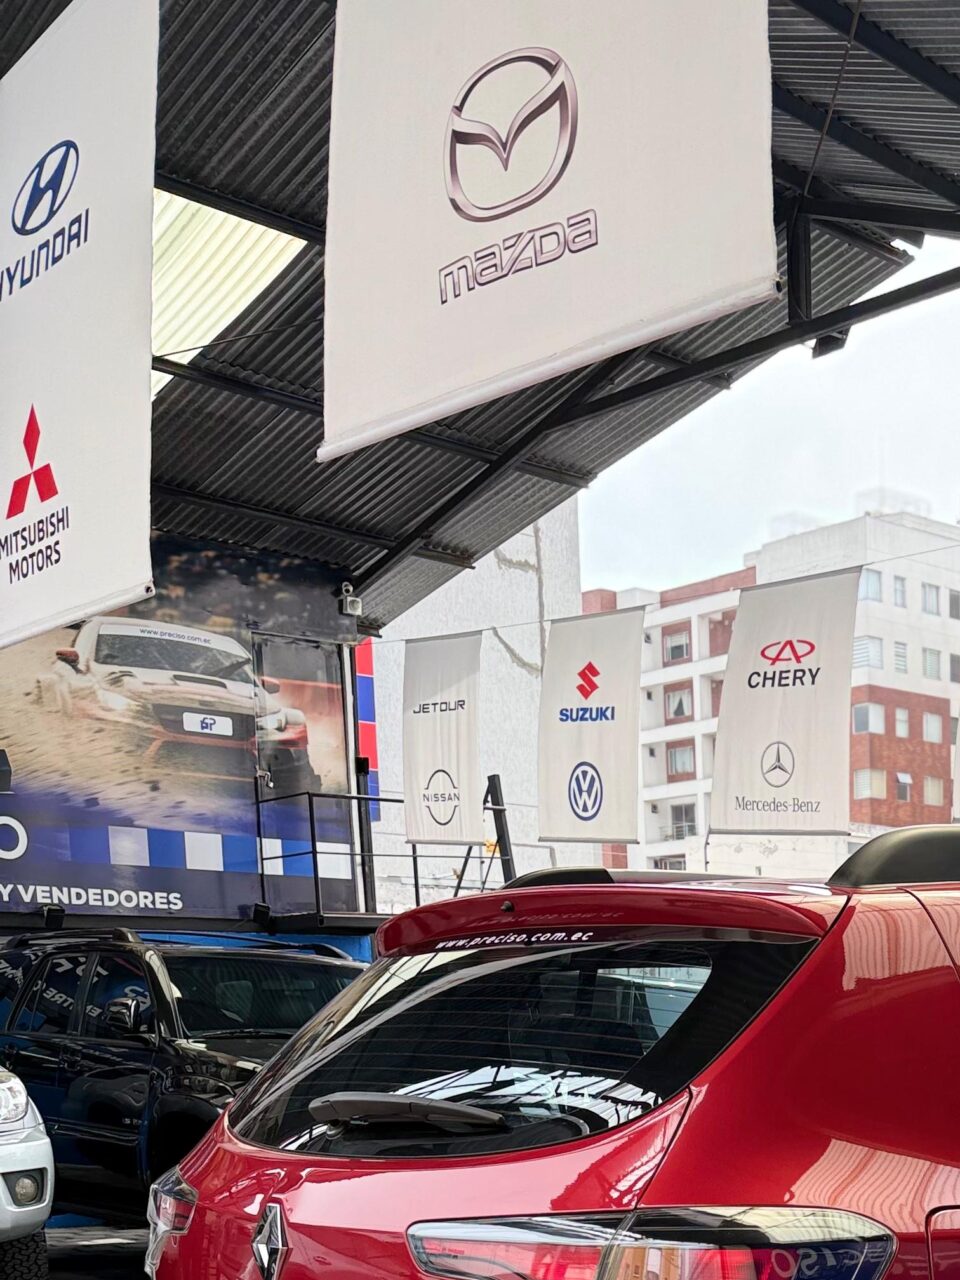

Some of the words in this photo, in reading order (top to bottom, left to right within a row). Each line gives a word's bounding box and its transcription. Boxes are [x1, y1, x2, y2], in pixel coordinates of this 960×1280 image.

[0, 505, 70, 560] MITSUBISHI
[8, 540, 61, 585] MOTORS
[747, 667, 822, 689] CHERY
[412, 699, 466, 714] JETOUR
[558, 706, 616, 722] SUZUKI
[422, 793, 461, 802] NISSAN
[734, 795, 822, 813] Mercedes-Benz
[17, 884, 184, 911] VENDEDORES
[434, 931, 595, 950] www.preciso.com.ec
